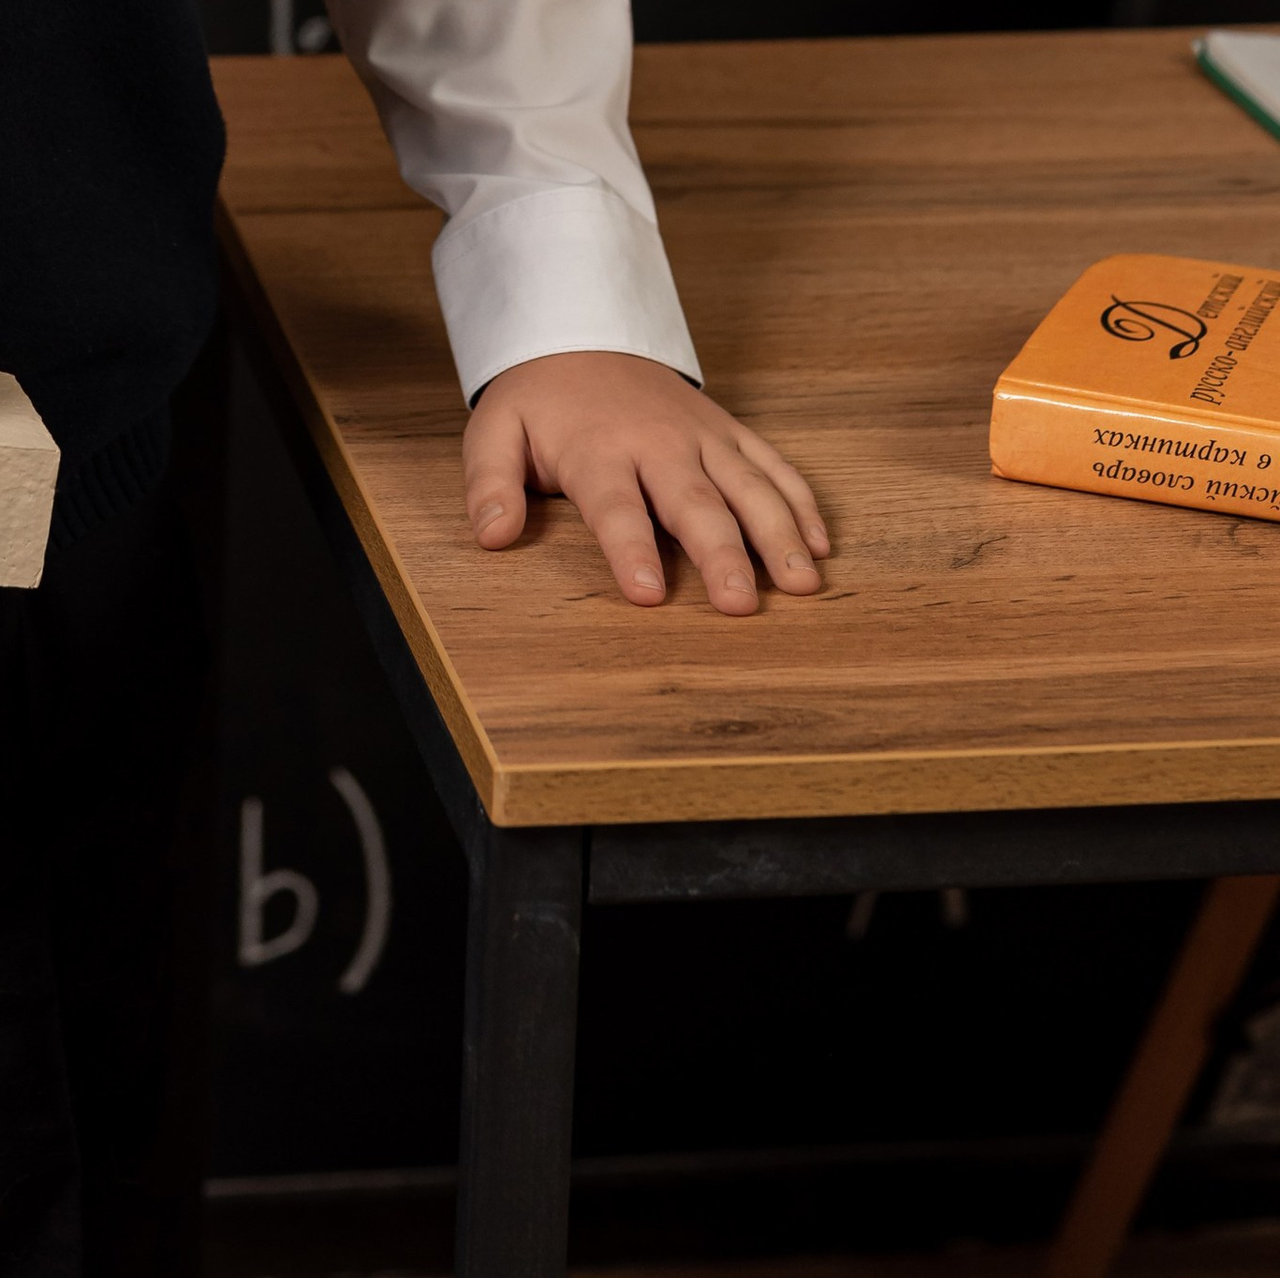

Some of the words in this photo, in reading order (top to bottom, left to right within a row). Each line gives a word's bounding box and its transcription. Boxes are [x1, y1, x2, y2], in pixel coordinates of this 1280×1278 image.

[1093, 428, 1247, 466] картинках
[1256, 453, 1272, 470] в
[1092, 459, 1195, 491] словарь
